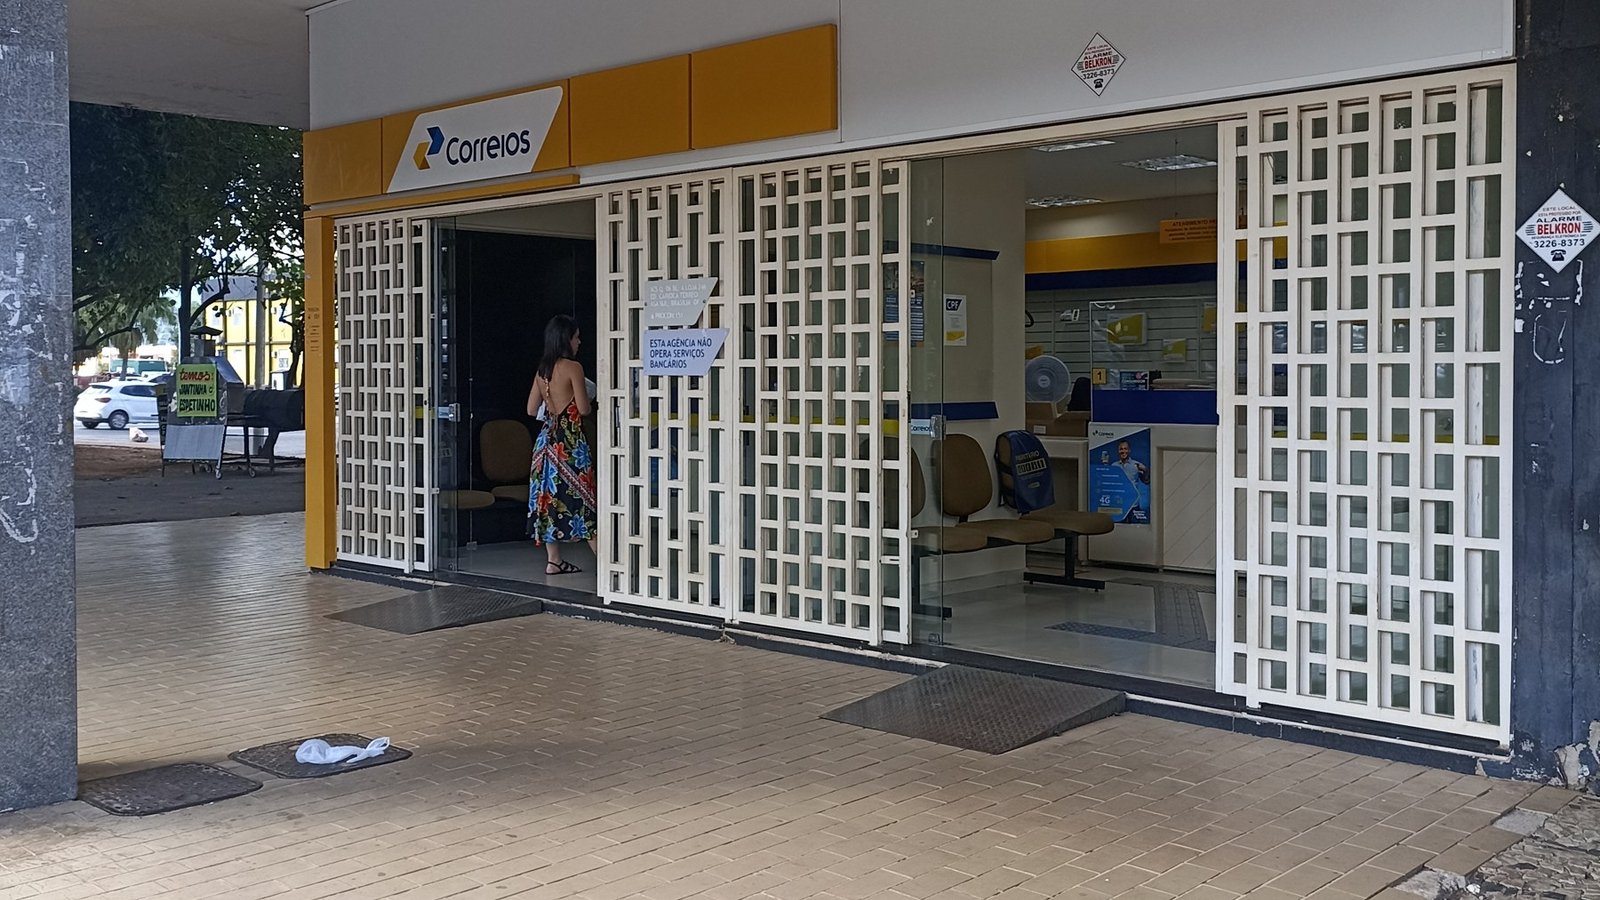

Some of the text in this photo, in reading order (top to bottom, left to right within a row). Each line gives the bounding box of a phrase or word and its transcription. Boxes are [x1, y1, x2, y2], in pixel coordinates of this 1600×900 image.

[1084, 51, 1113, 61] ALARME
[1084, 56, 1112, 70] BELKRON
[1083, 68, 1115, 80] 3226-8373
[446, 129, 531, 166] Correios
[1536, 215, 1582, 223] ALARME
[1537, 222, 1581, 235] BELKRON
[1534, 238, 1585, 249] 3226-8373
[946, 300, 959, 310] CPF
[649, 336, 712, 348] ESTA AGÊNCIA NÃO
[649, 348, 705, 359] OPERA SERVIÇOS
[650, 357, 687, 369] BANCÁRIOS
[179, 384, 207, 395] JANTINHA
[179, 398, 216, 412] ESPETINHO
[1099, 496, 1111, 504] 4G
